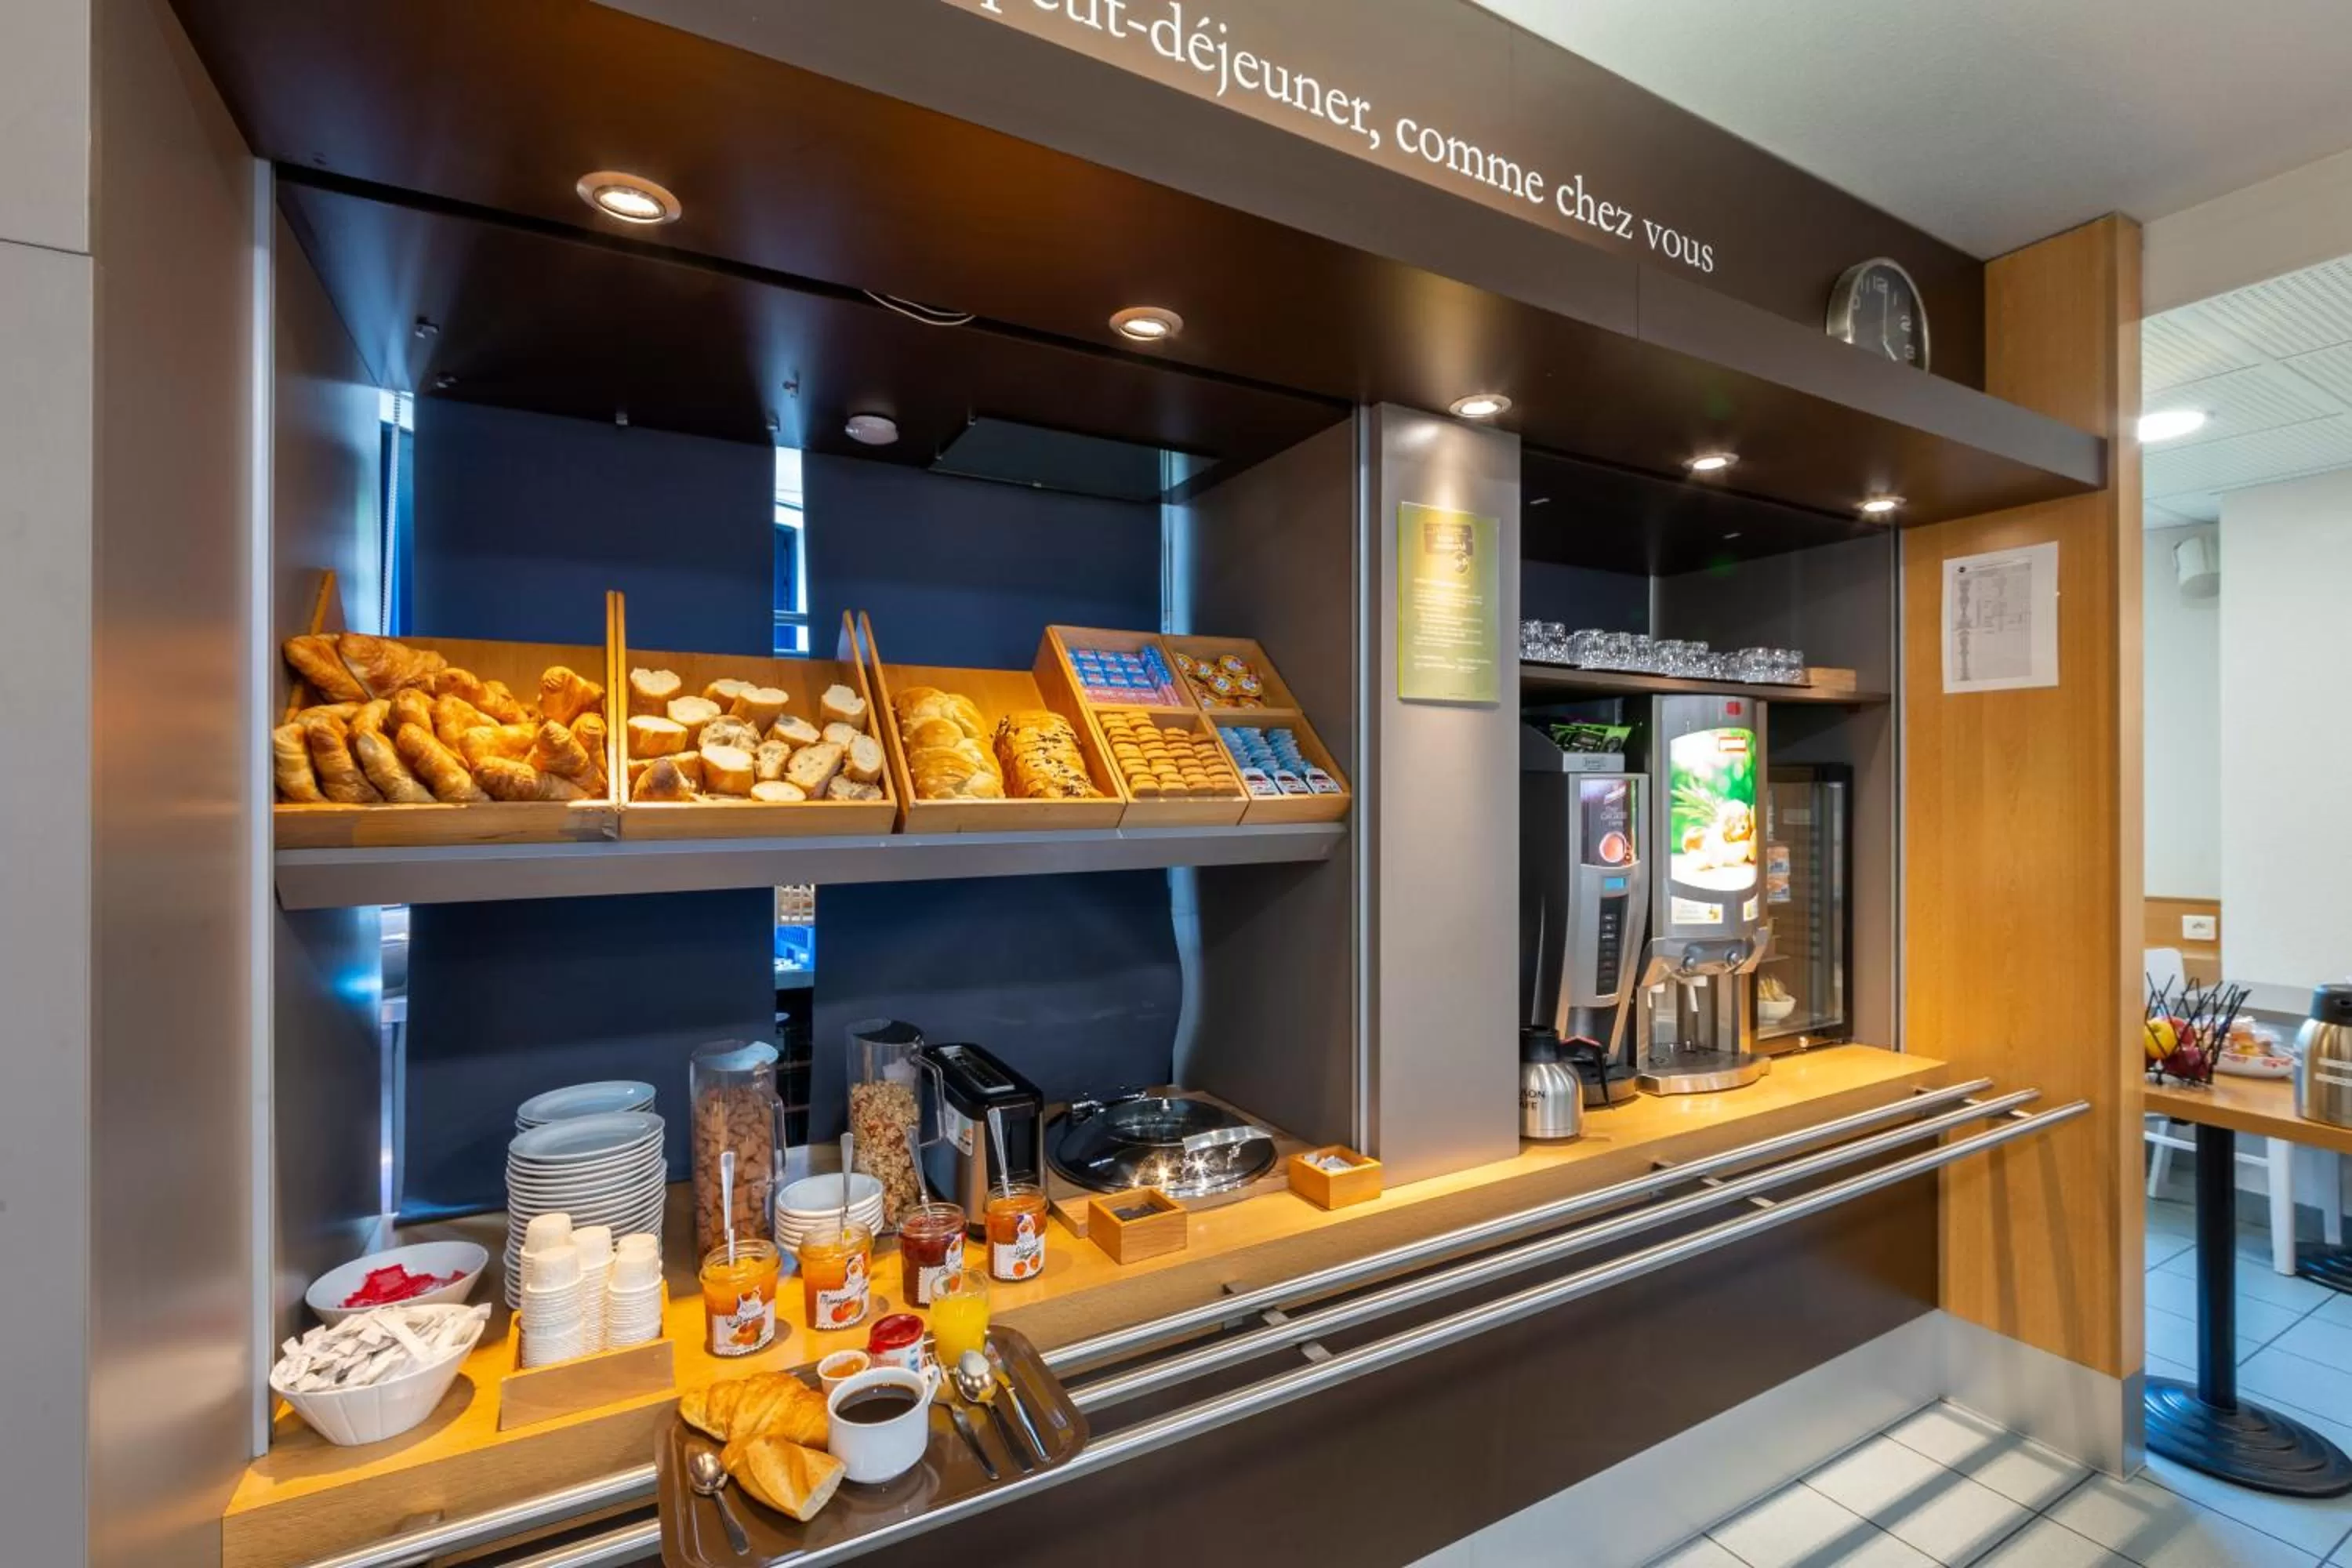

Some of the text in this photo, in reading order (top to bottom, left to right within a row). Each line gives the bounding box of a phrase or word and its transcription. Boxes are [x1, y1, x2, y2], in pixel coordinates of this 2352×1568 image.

[980, 0, 1715, 273] t-déjeuner, comme chez vous
[1872, 275, 1889, 294] 12
[1899, 314, 1912, 332] 2
